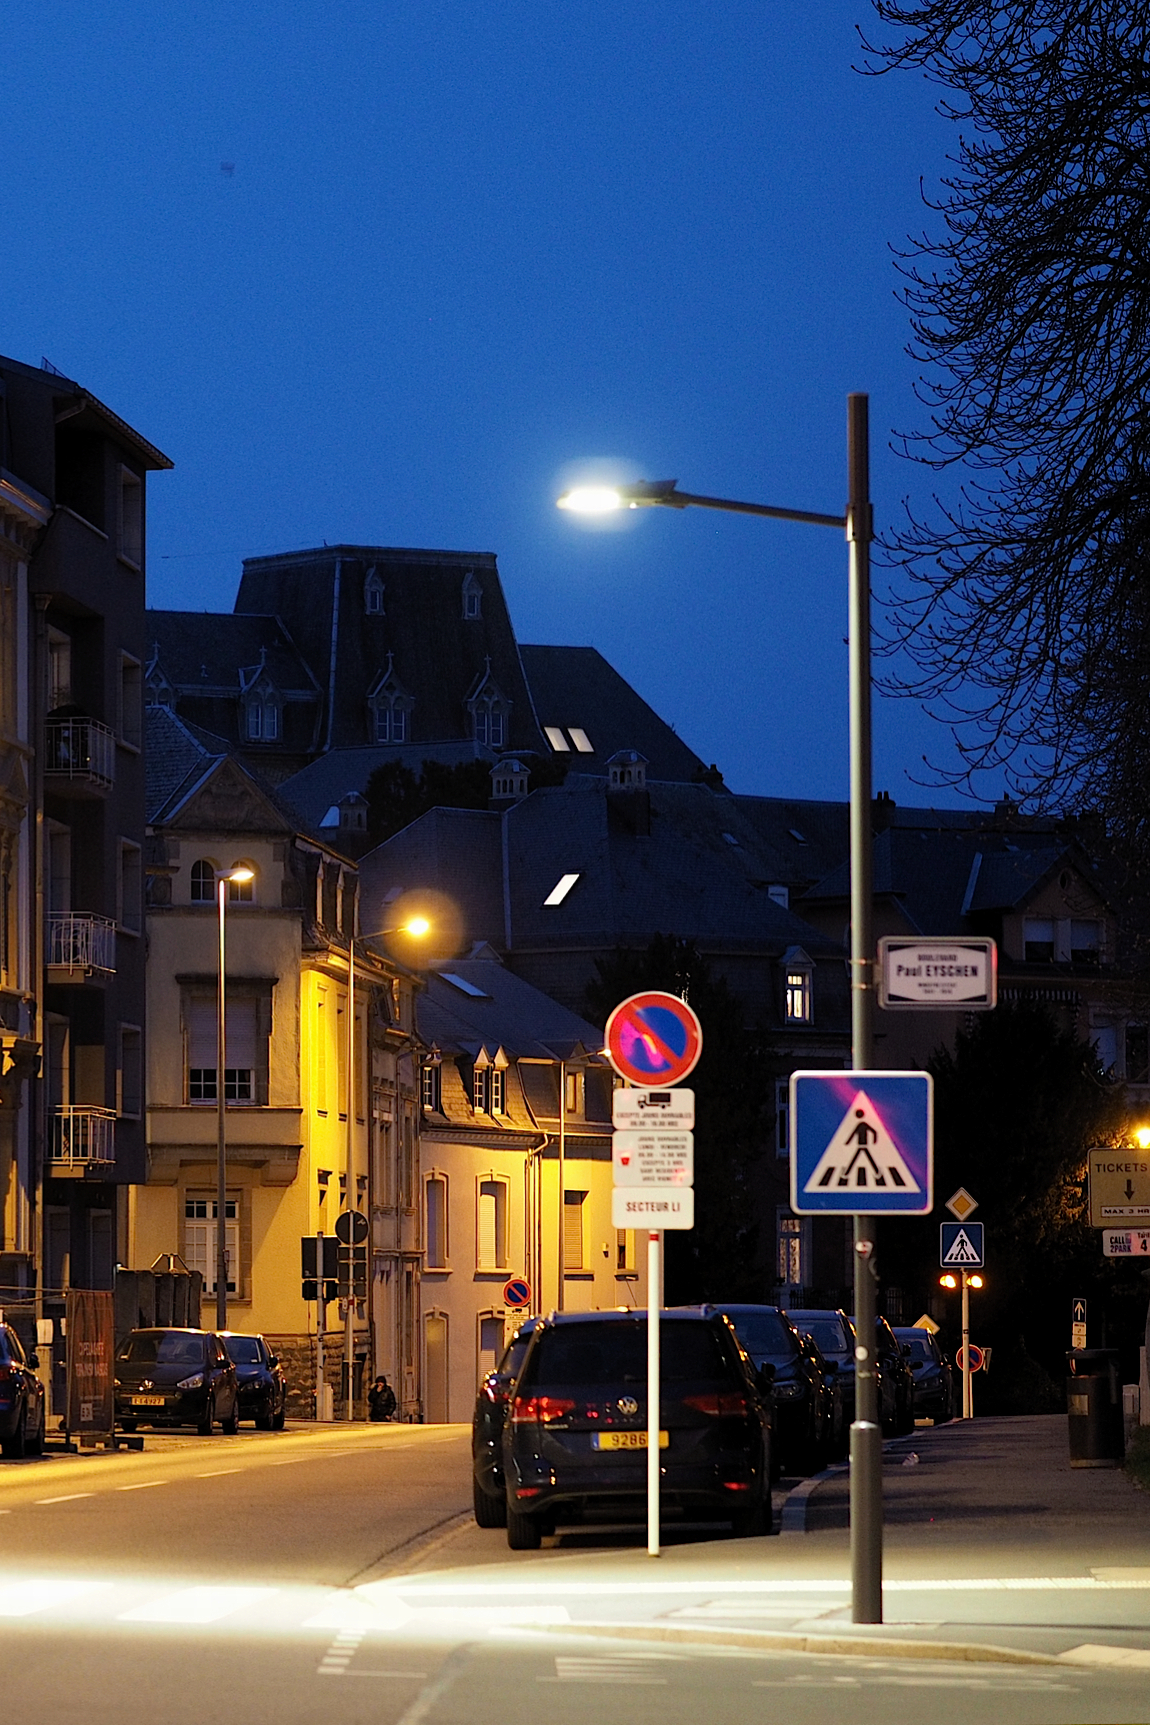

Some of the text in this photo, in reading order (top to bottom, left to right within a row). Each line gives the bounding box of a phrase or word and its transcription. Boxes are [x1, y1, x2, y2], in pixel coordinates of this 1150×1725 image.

[897, 965, 978, 977] Paul EYSCHEN
[1095, 1163, 1148, 1173] TICKETS
[625, 1202, 669, 1212] SECTEUR
[1110, 1236, 1148, 1251] CALL 4
